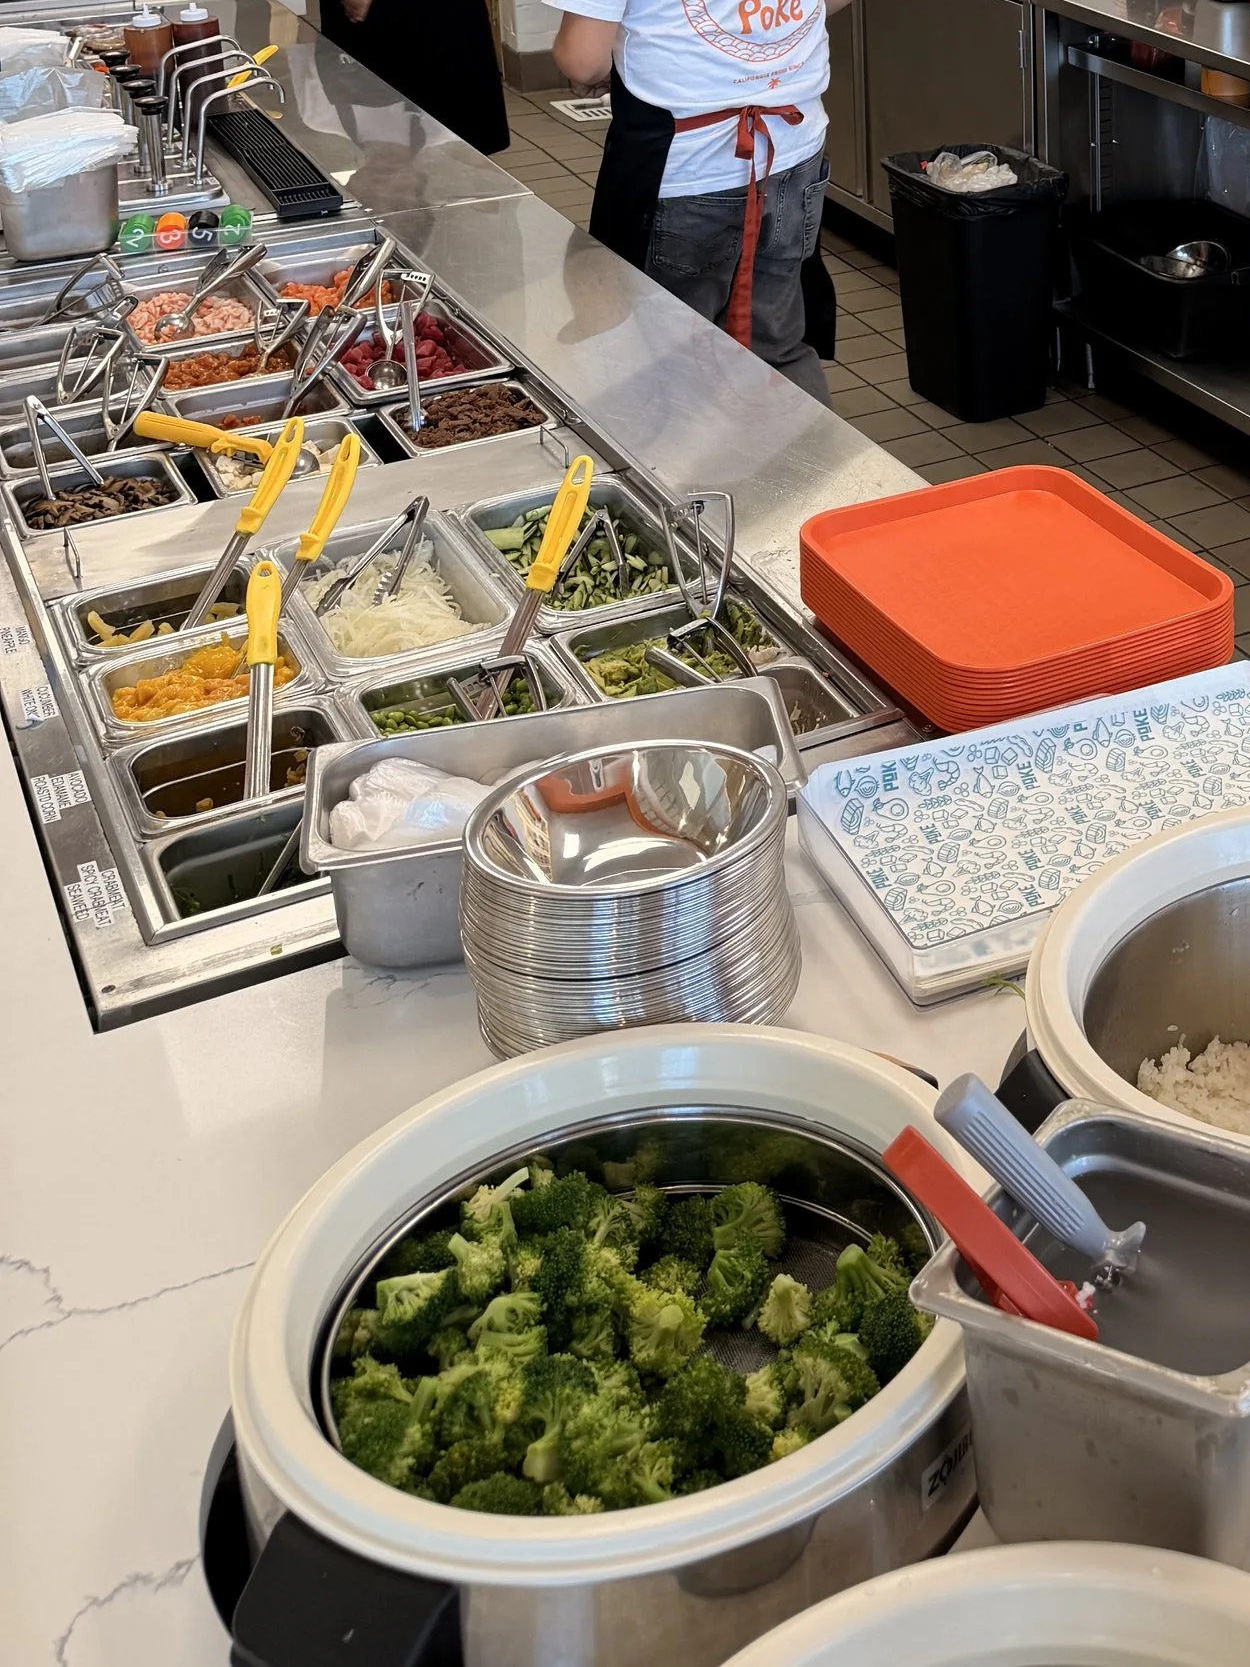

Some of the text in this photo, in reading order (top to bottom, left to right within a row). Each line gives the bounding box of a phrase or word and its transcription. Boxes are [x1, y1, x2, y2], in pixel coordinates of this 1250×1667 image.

[38, 687, 55, 717] CUCUMBER
[52, 776, 71, 809] EDAMAME
[69, 772, 89, 804] AVOCADO
[67, 884, 89, 922] SEAWEED
[82, 864, 111, 927] SPICY CRABMEAT
[102, 870, 125, 911] CRABMEAT
